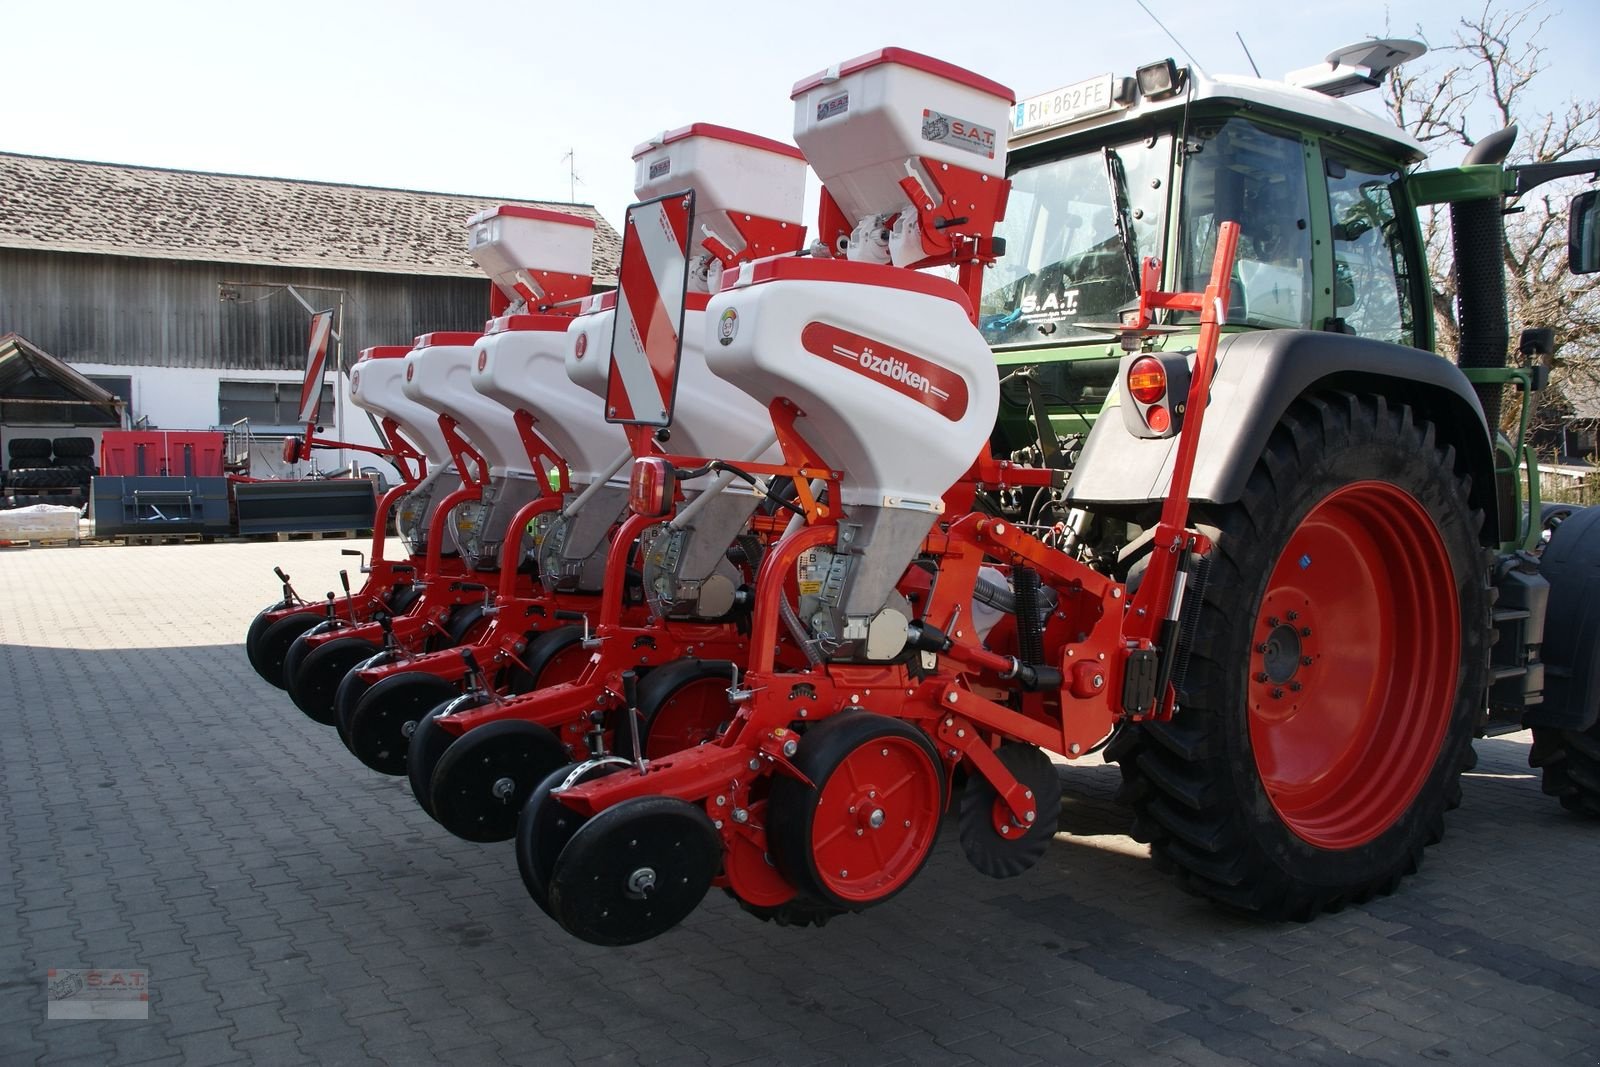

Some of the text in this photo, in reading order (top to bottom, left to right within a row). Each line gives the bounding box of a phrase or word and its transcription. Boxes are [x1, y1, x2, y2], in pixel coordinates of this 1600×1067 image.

[1028, 100, 1042, 121] RI
[952, 121, 994, 145] S.A.T.
[1021, 289, 1079, 313] S.A.T.
[860, 346, 930, 394] özdöken
